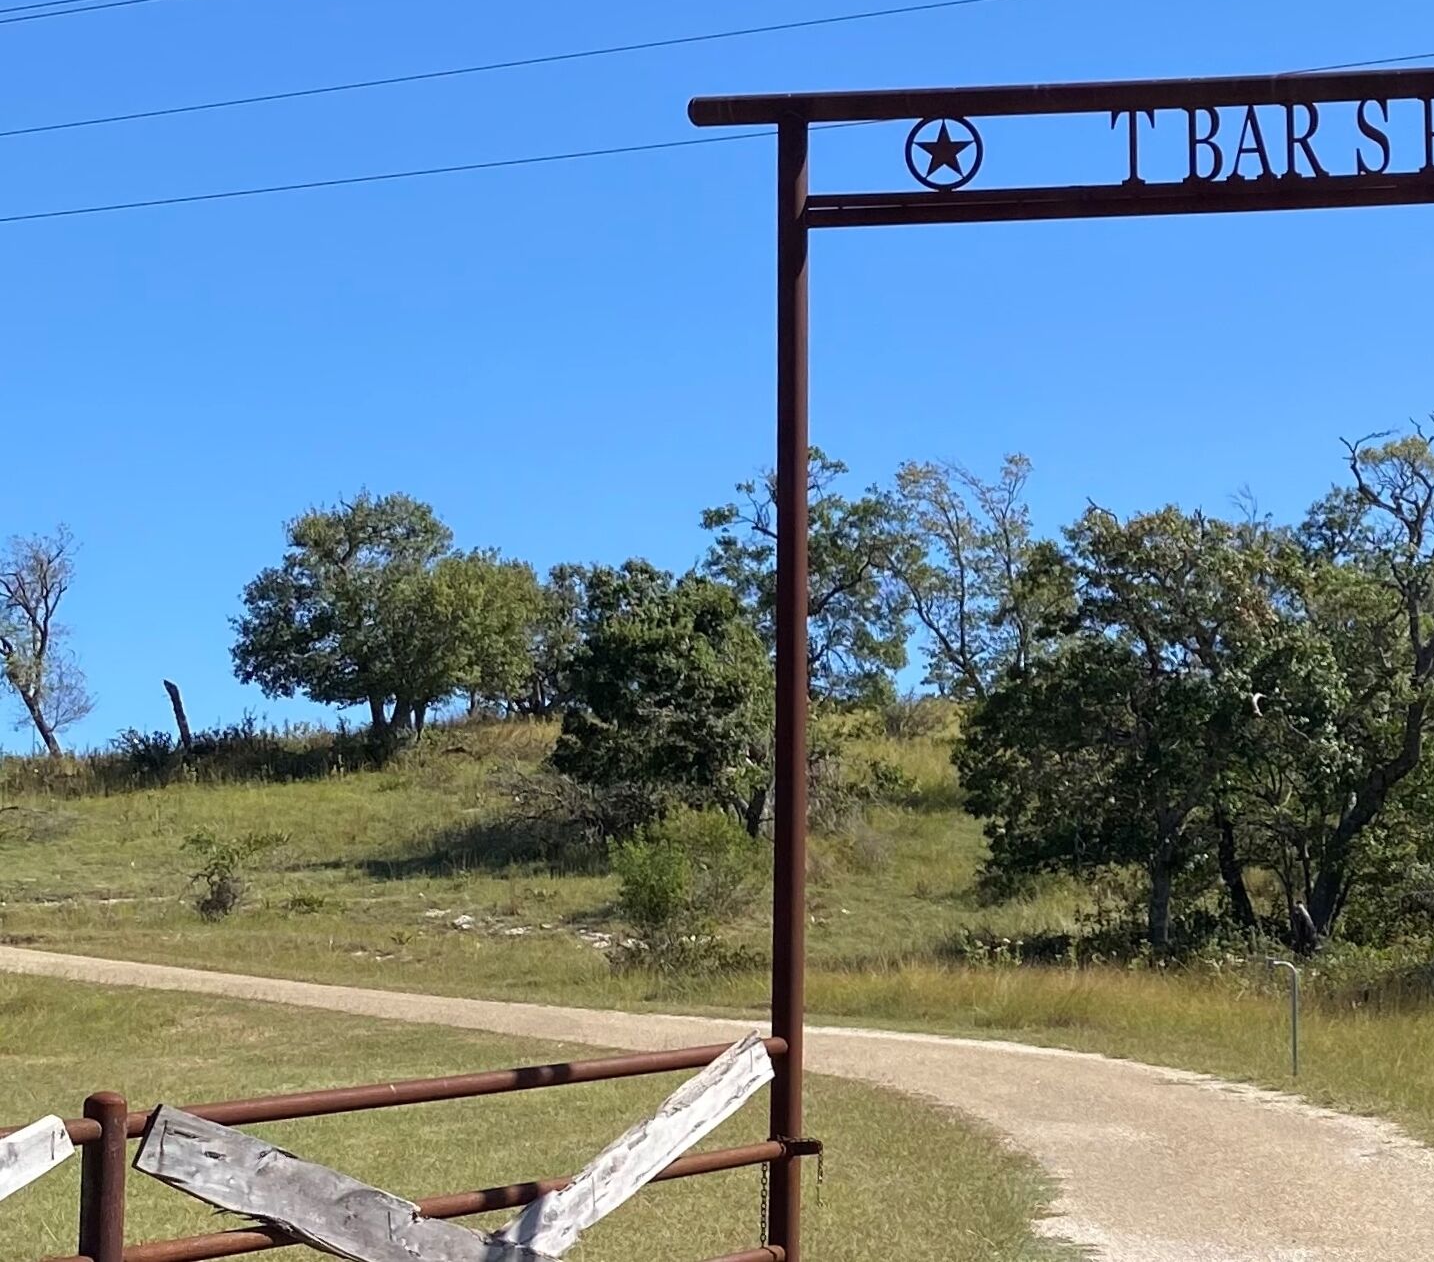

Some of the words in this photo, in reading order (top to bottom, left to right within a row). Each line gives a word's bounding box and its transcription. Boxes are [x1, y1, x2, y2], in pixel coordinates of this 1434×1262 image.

[1110, 108, 1156, 185] T
[1182, 102, 1330, 184] BAR
[1356, 98, 1391, 176] S
